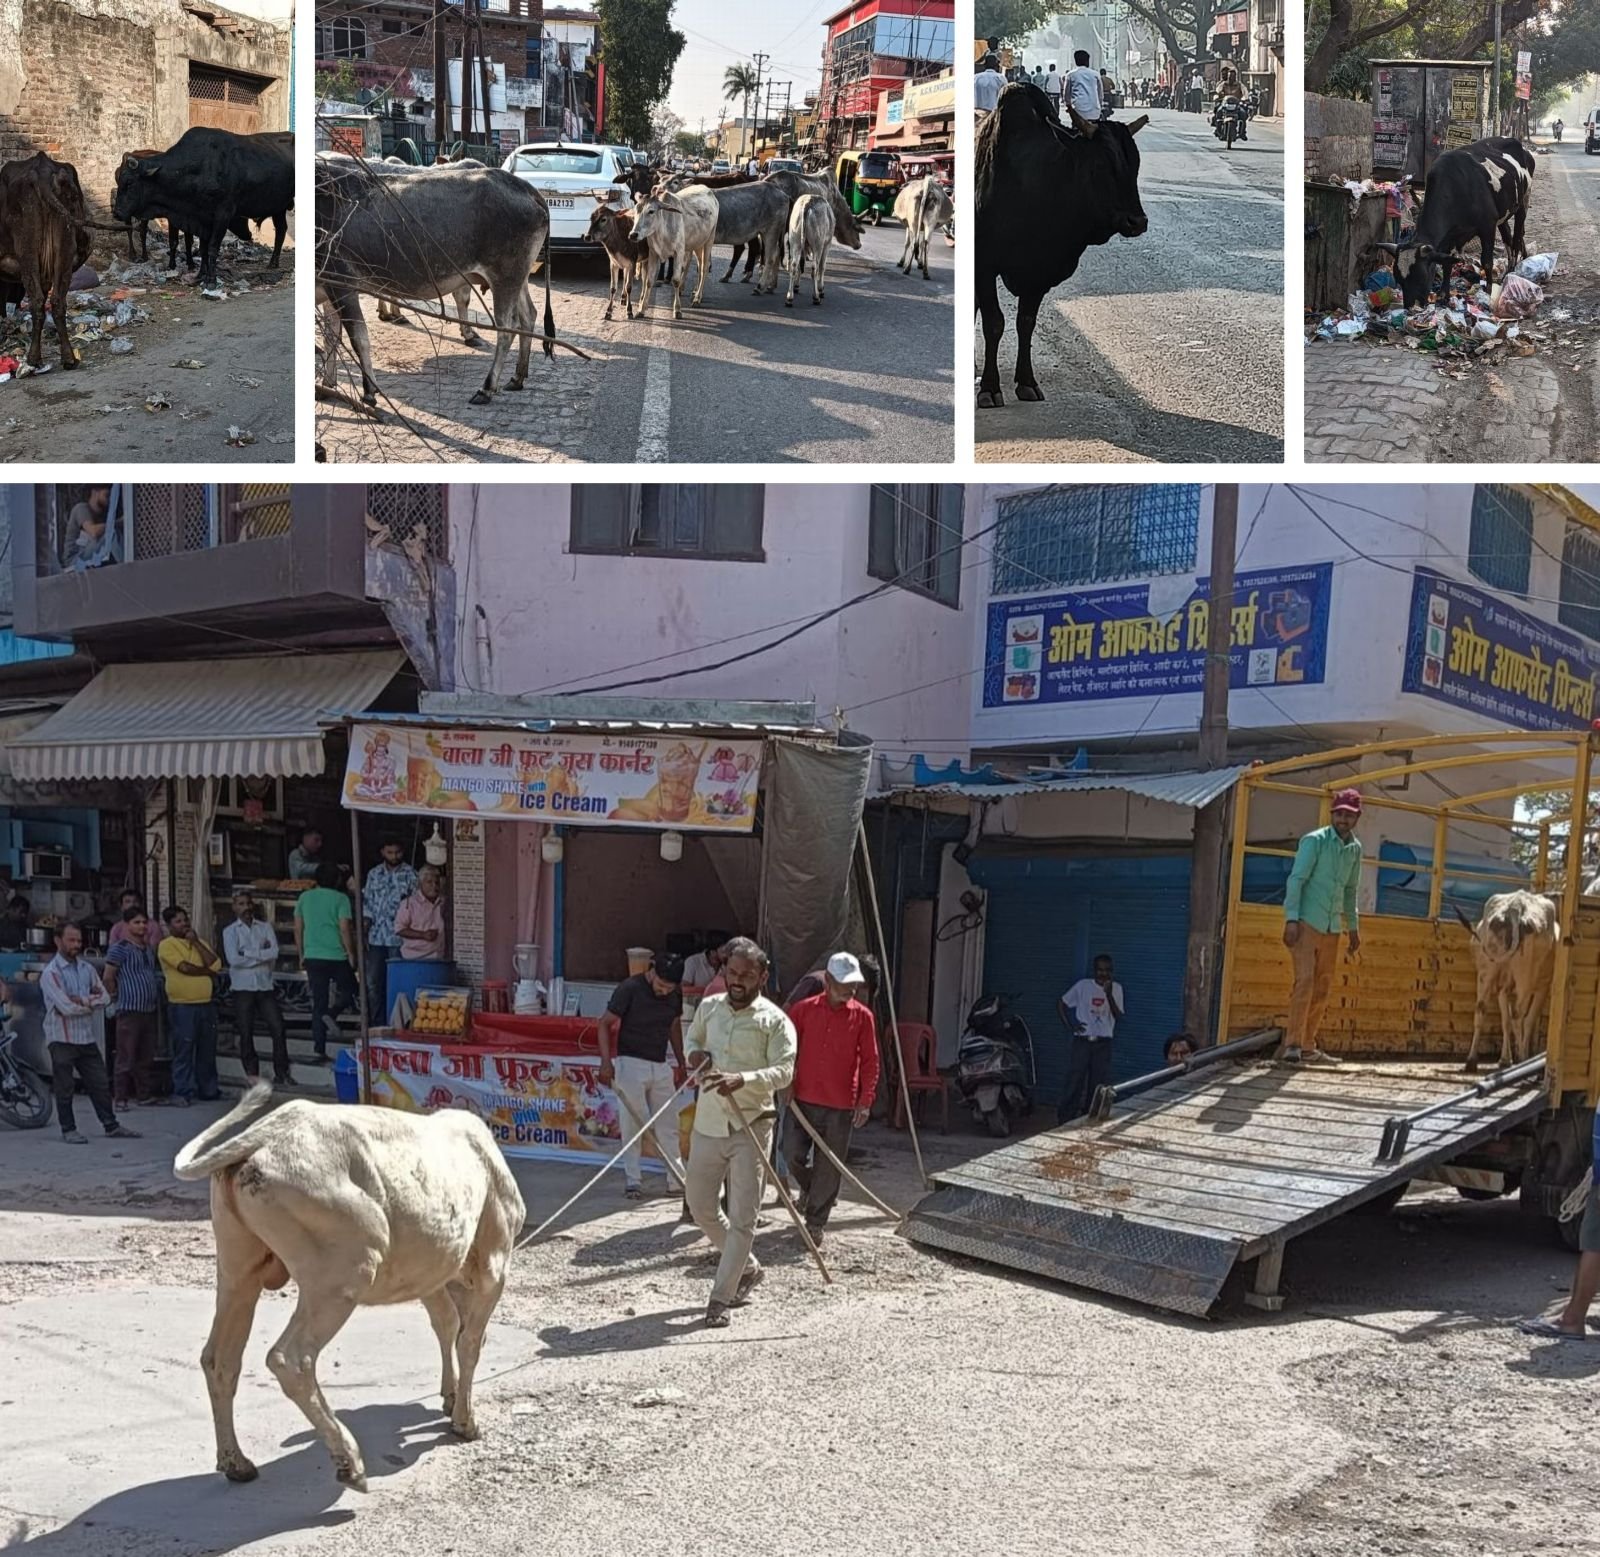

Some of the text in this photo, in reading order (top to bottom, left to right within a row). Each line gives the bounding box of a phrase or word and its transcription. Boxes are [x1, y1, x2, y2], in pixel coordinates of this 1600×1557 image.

[1048, 612, 1094, 664] ओम
[1448, 615, 1490, 682] ओम
[490, 743, 513, 767] जी
[559, 752, 594, 776] जूस
[441, 777, 546, 795] MANGO SHAKE with
[552, 792, 607, 813] Cream
[483, 1092, 566, 1113] MANGO SHAKE
[511, 1108, 541, 1125] with
[515, 1123, 568, 1145] Cream
